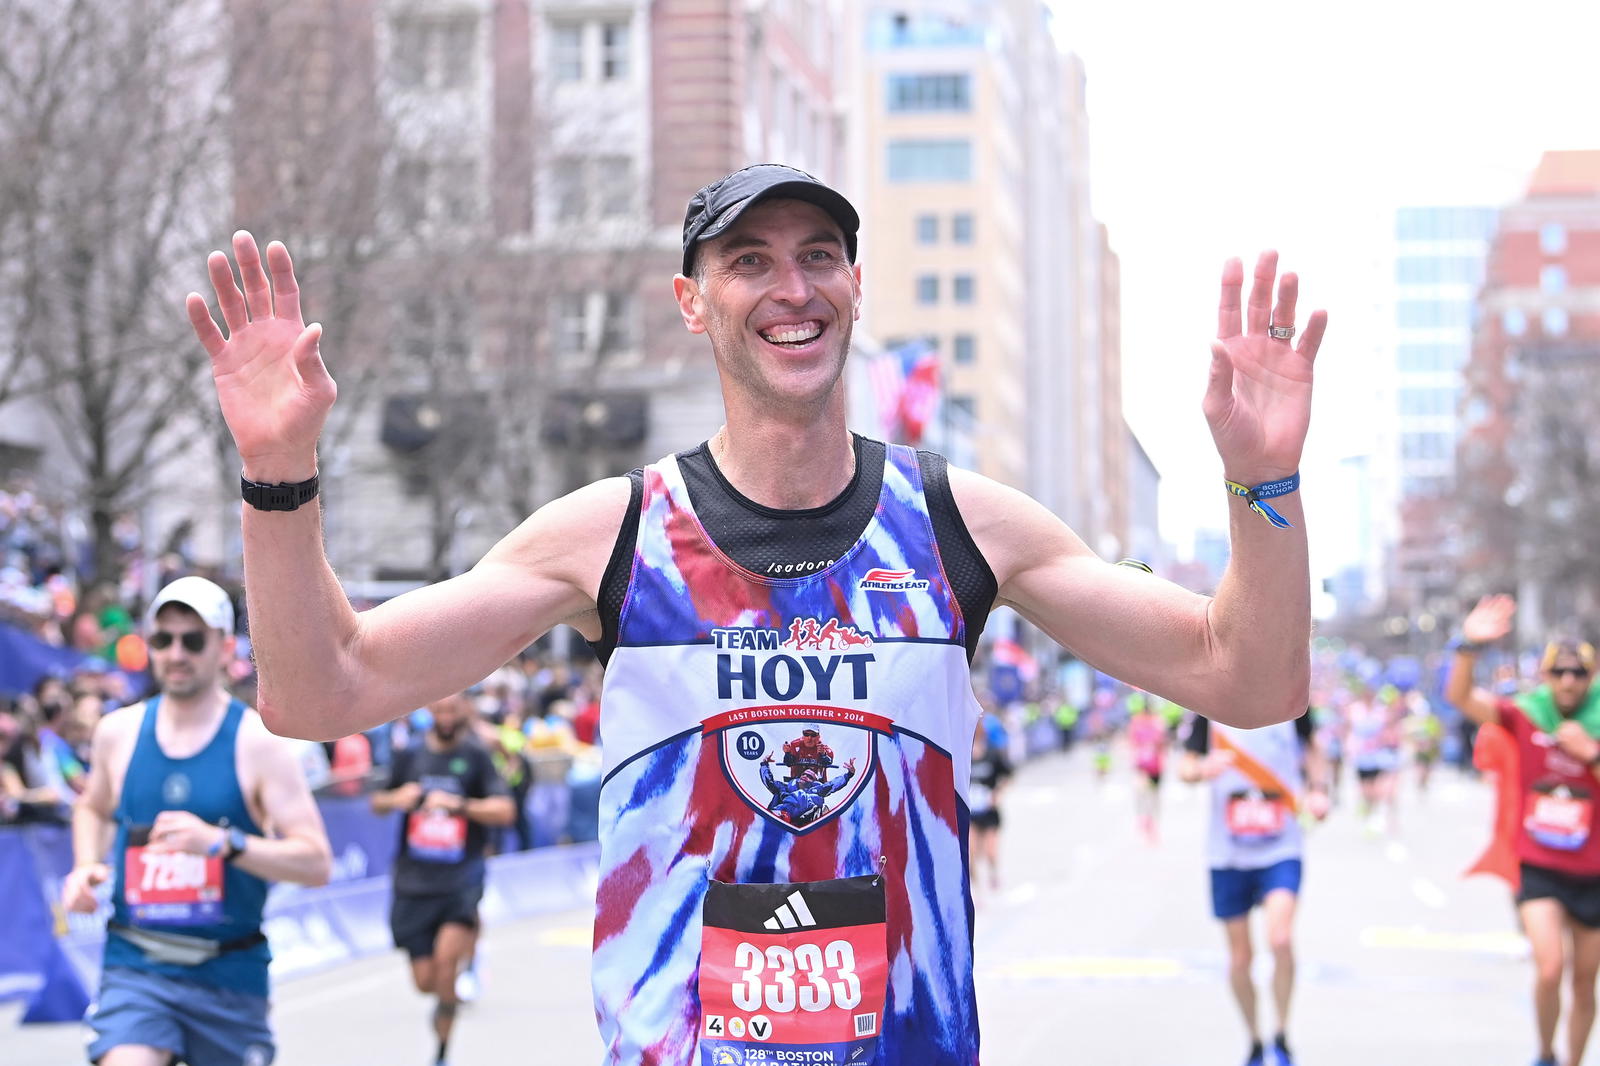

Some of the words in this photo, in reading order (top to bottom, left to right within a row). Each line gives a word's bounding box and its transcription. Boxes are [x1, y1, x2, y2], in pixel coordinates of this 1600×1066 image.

[1257, 485, 1293, 496] RATHON
[1262, 480, 1293, 491] BOSTON
[767, 559, 834, 573] Isadore
[860, 581, 904, 590] ATHLETICS
[905, 581, 928, 589] EAST
[713, 631, 778, 650] TEAM
[717, 653, 876, 701] HOYT
[728, 711, 748, 722] LAST
[751, 708, 786, 718] BOSTON
[789, 708, 834, 718] TOGETHER
[844, 712, 865, 722] 2014
[742, 736, 760, 750] 10
[731, 940, 862, 1013] 3333
[708, 1018, 722, 1033] 4
[751, 1022, 767, 1037] V
[776, 1050, 834, 1062] BOSTON
